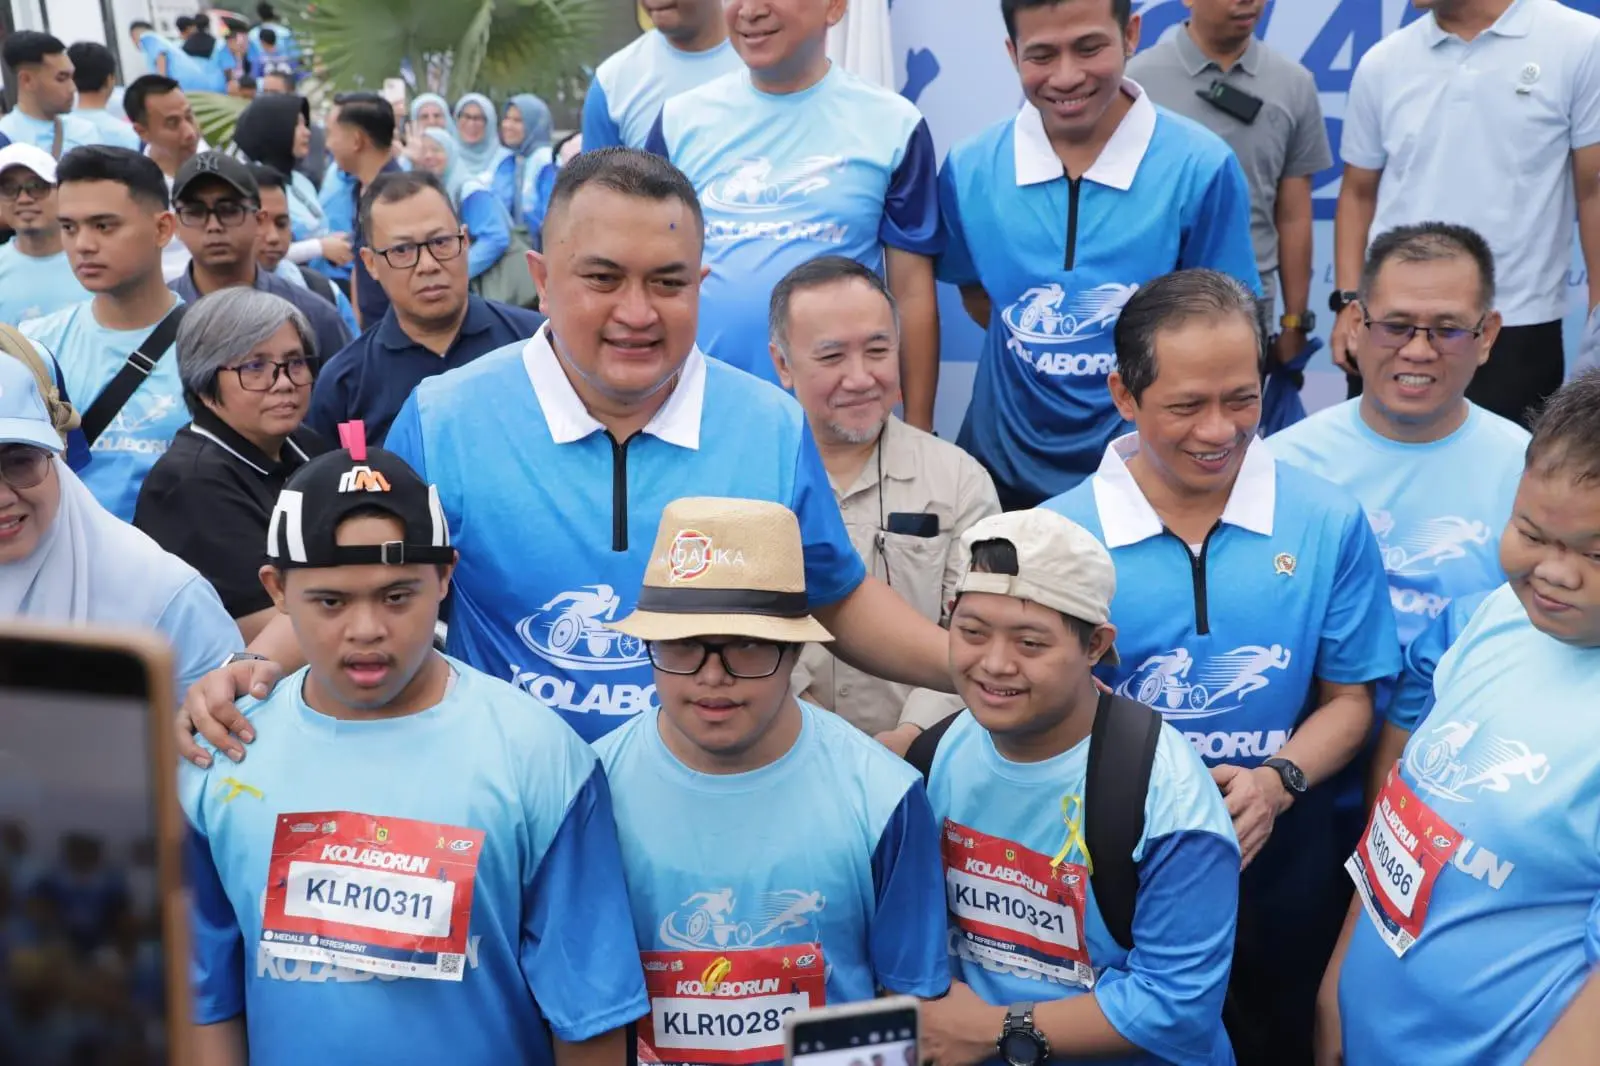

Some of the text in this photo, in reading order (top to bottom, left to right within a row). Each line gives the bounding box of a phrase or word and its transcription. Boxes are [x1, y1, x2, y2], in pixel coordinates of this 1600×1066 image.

[320, 844, 430, 873] KOLABORUN
[965, 857, 1048, 897] KOLABORUN
[305, 877, 433, 920] KLR10311
[955, 883, 1064, 934] KLR10321
